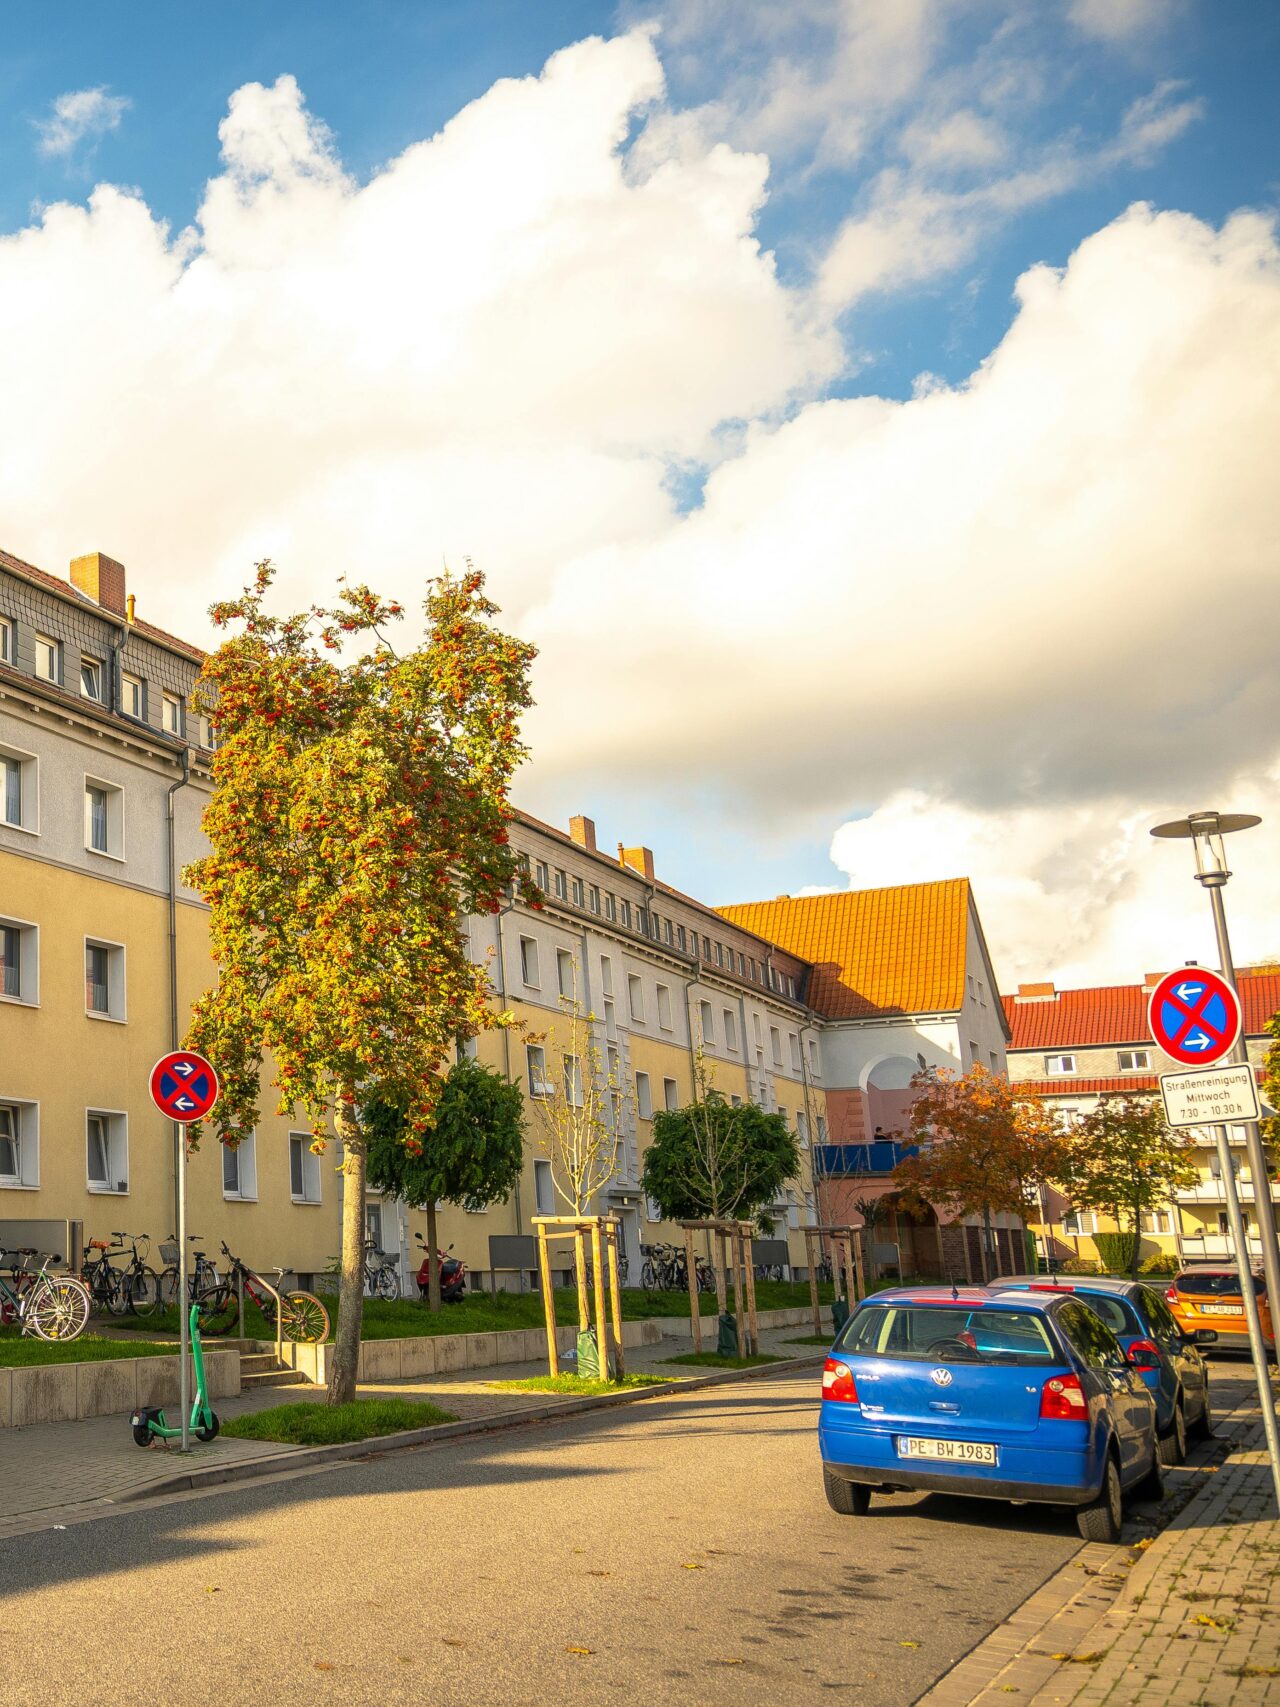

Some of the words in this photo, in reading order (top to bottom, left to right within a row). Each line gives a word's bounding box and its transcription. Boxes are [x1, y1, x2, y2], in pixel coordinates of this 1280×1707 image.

[1166, 1075, 1247, 1091] Straßenreinigung
[1186, 1090, 1231, 1103] Mittwoch
[1211, 1104, 1235, 1115] 10.30
[1237, 1103, 1242, 1112] h
[909, 1440, 926, 1454] PE
[937, 1442, 954, 1457] BW
[958, 1444, 992, 1461] 1983
